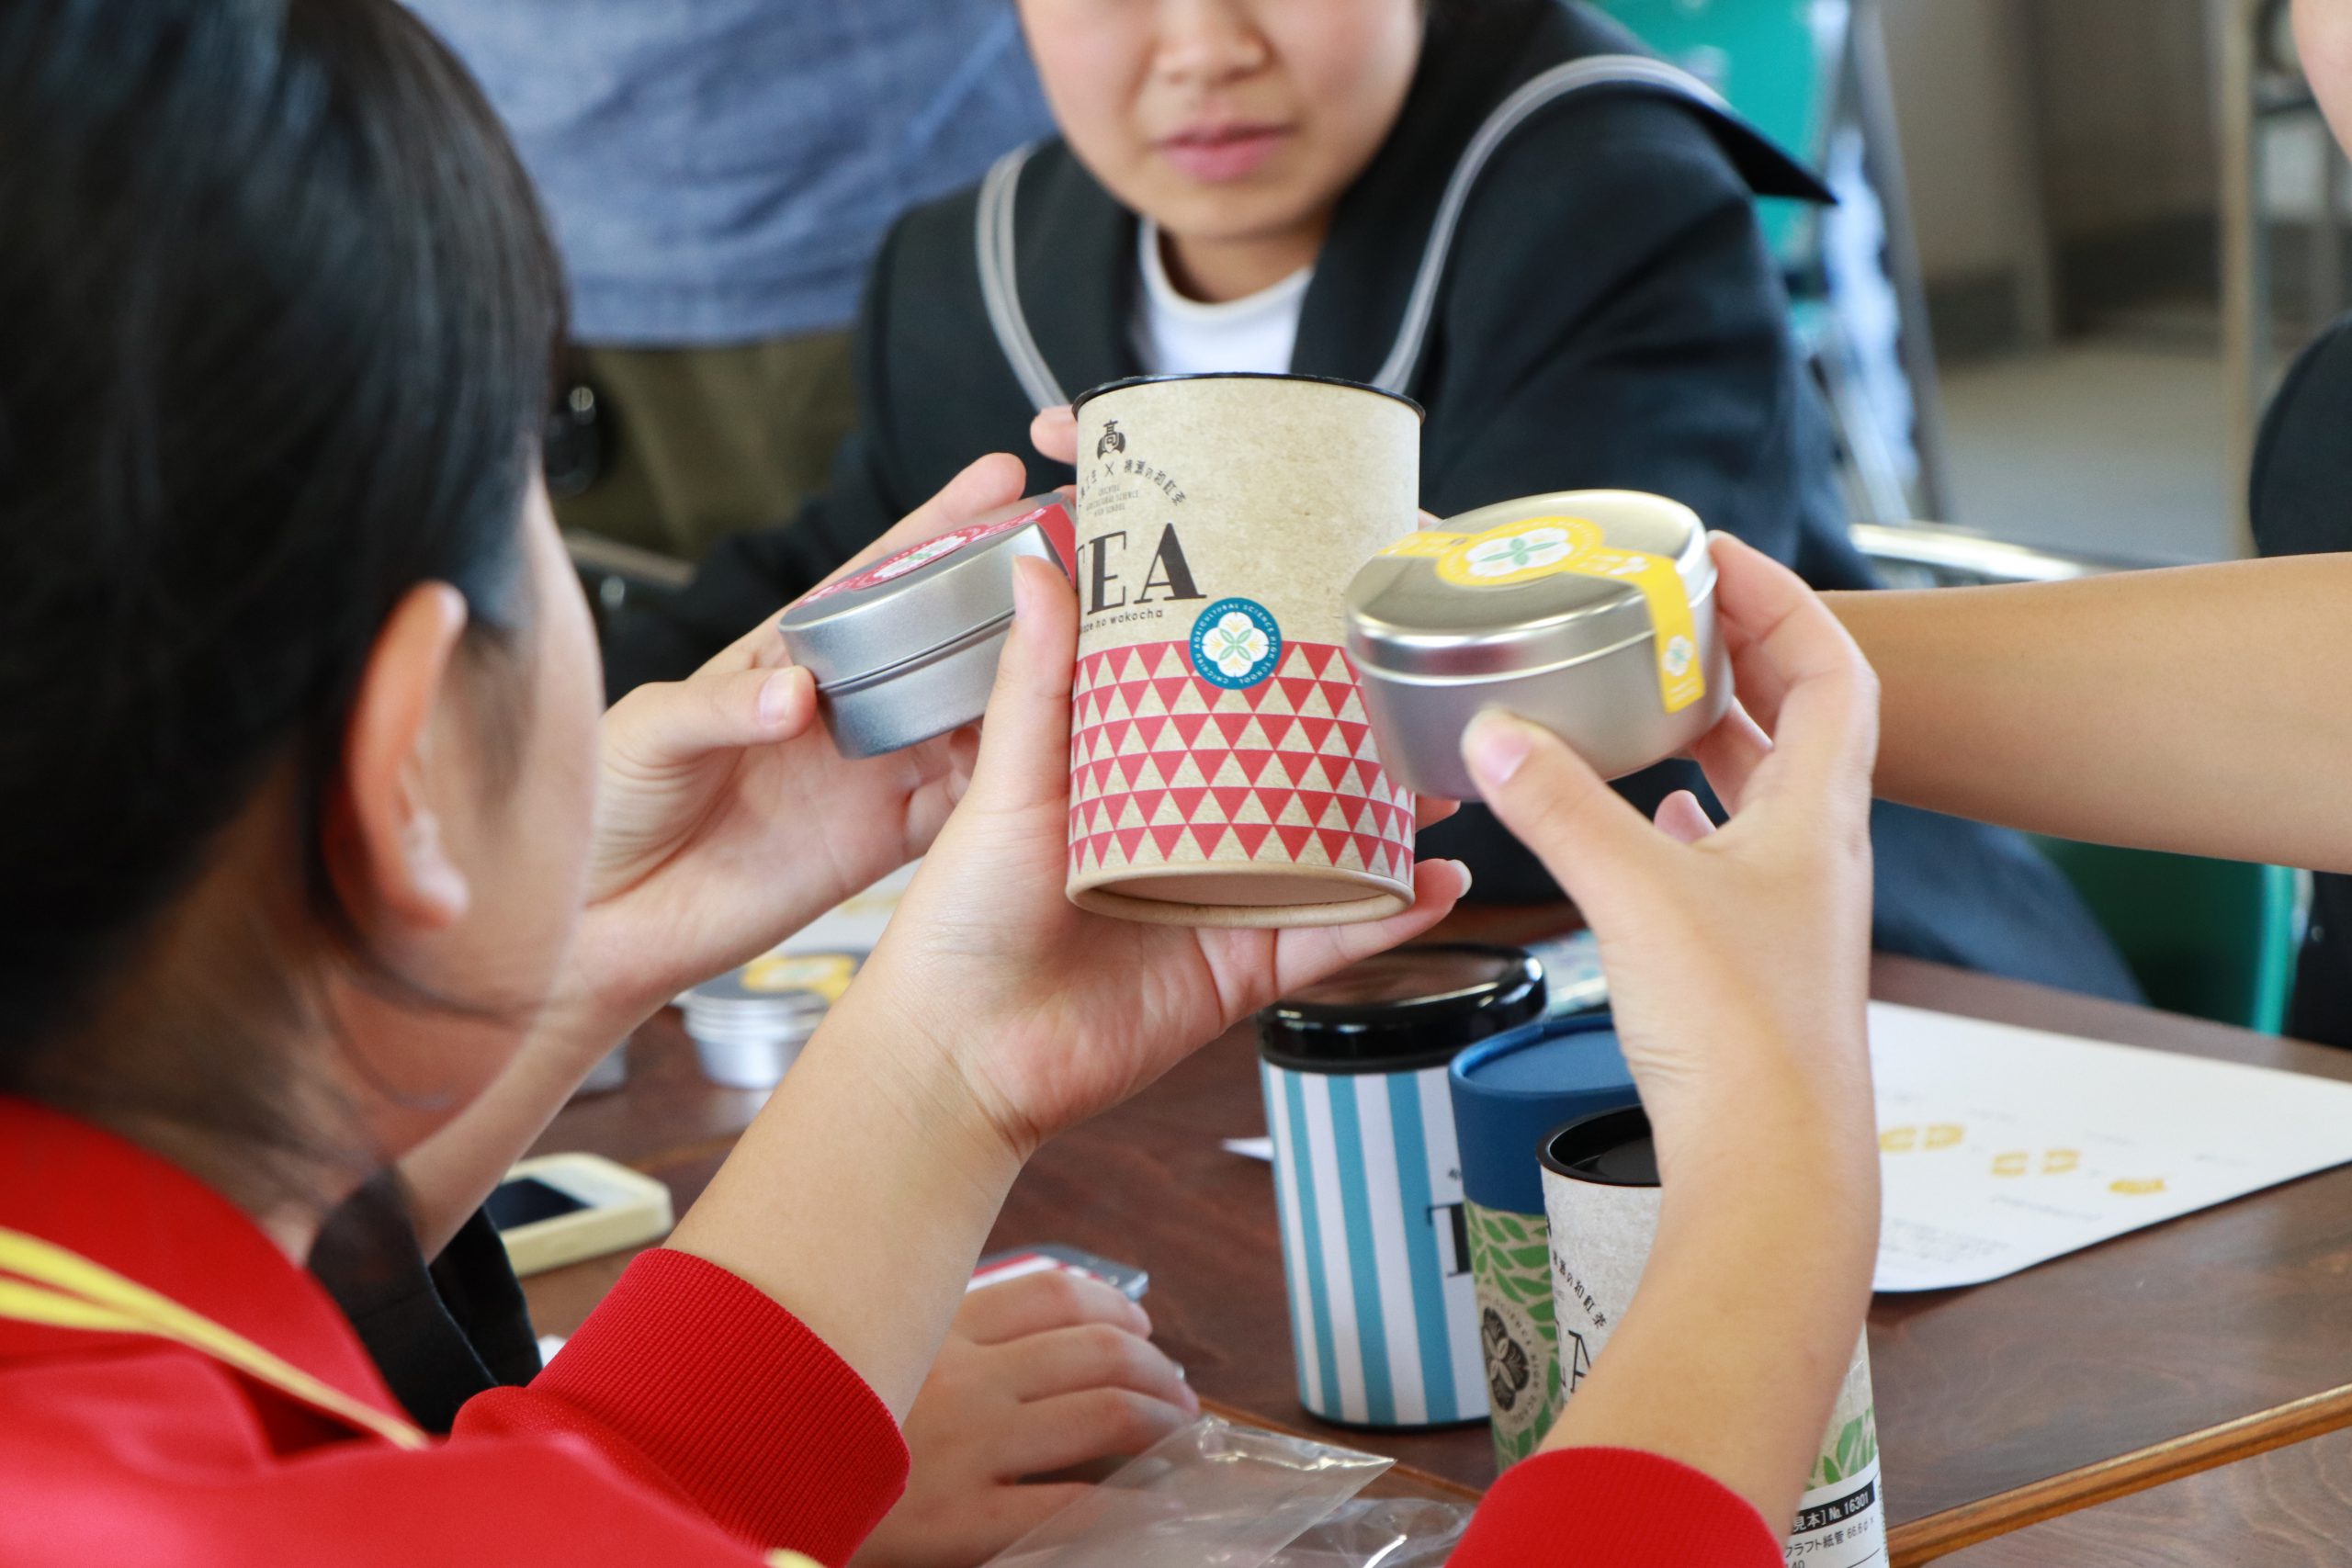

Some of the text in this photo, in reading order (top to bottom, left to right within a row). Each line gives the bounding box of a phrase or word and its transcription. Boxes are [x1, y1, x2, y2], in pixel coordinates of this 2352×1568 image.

[1110, 607, 1164, 626] wakocha
[1242, 604, 1275, 634] SCIENCE
[1844, 1491, 1869, 1515] 16301
